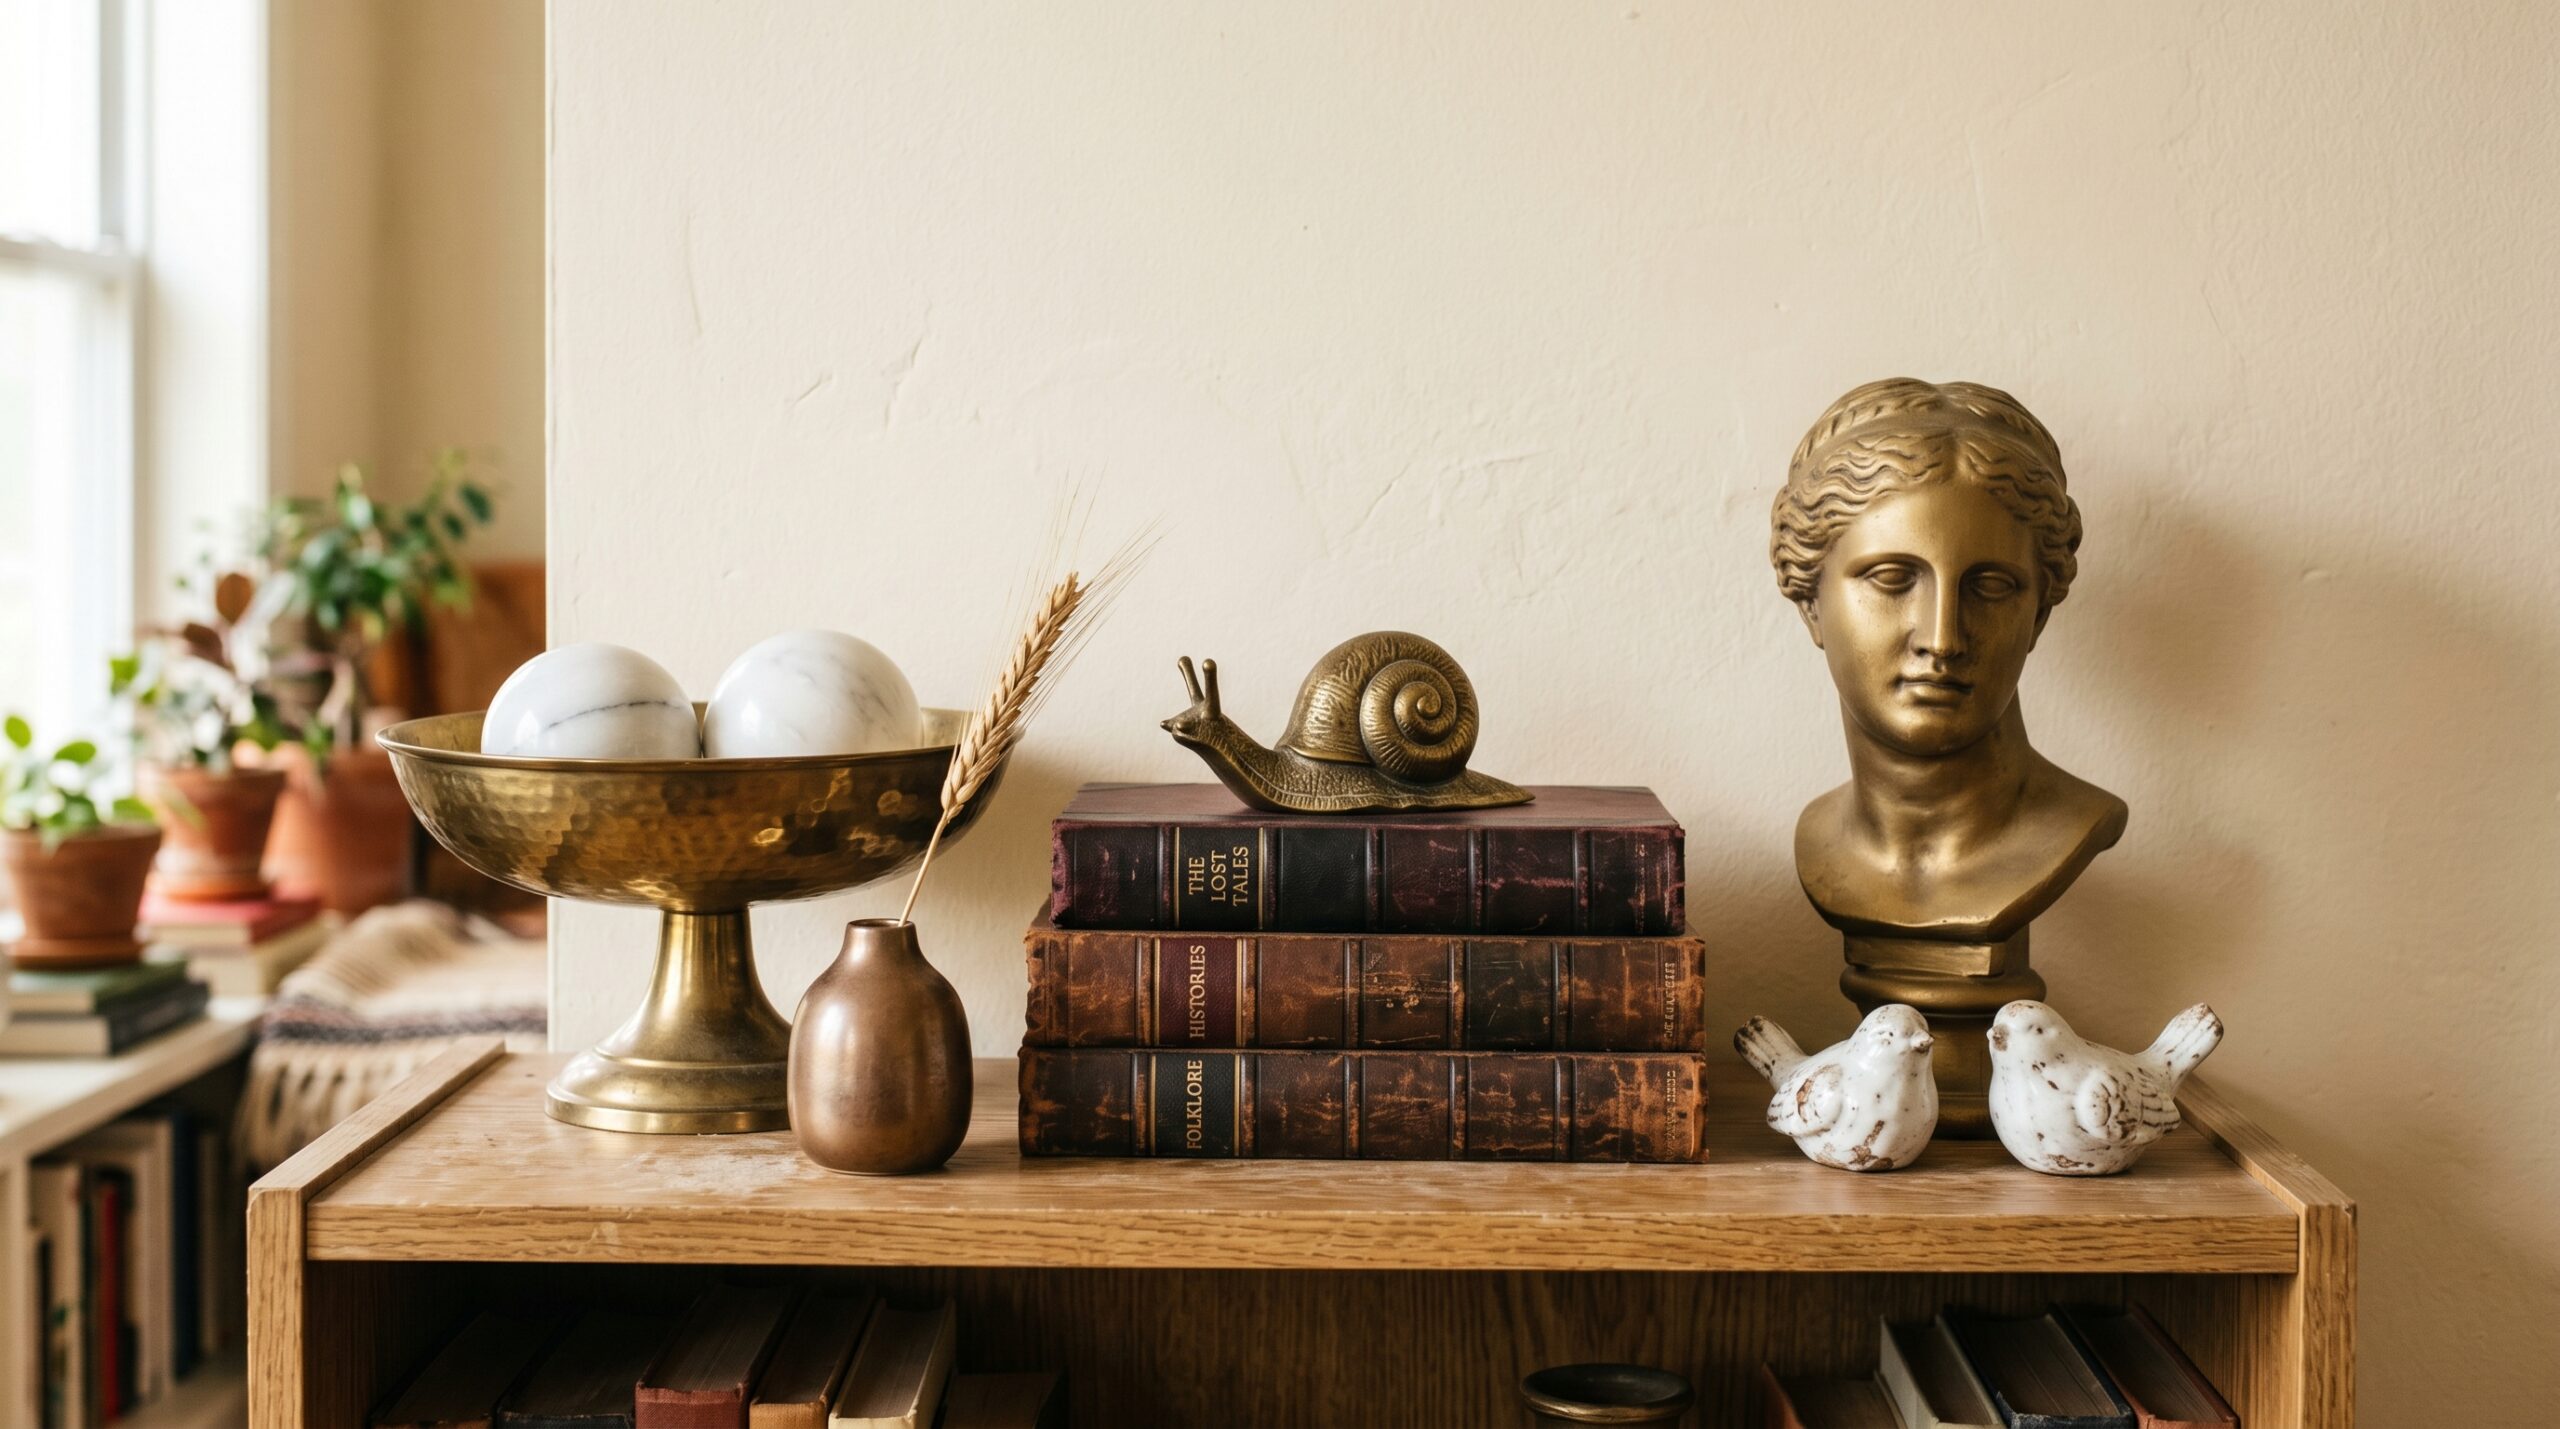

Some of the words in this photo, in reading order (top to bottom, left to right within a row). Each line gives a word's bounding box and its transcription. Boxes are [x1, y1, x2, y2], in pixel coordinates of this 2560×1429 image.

[1188, 857, 1205, 895] THE
[1211, 850, 1227, 902] LOST
[1233, 846, 1249, 907] TALES
[1189, 945, 1206, 1039] HISTORIES
[1186, 1060, 1203, 1149] FOLKLORE
